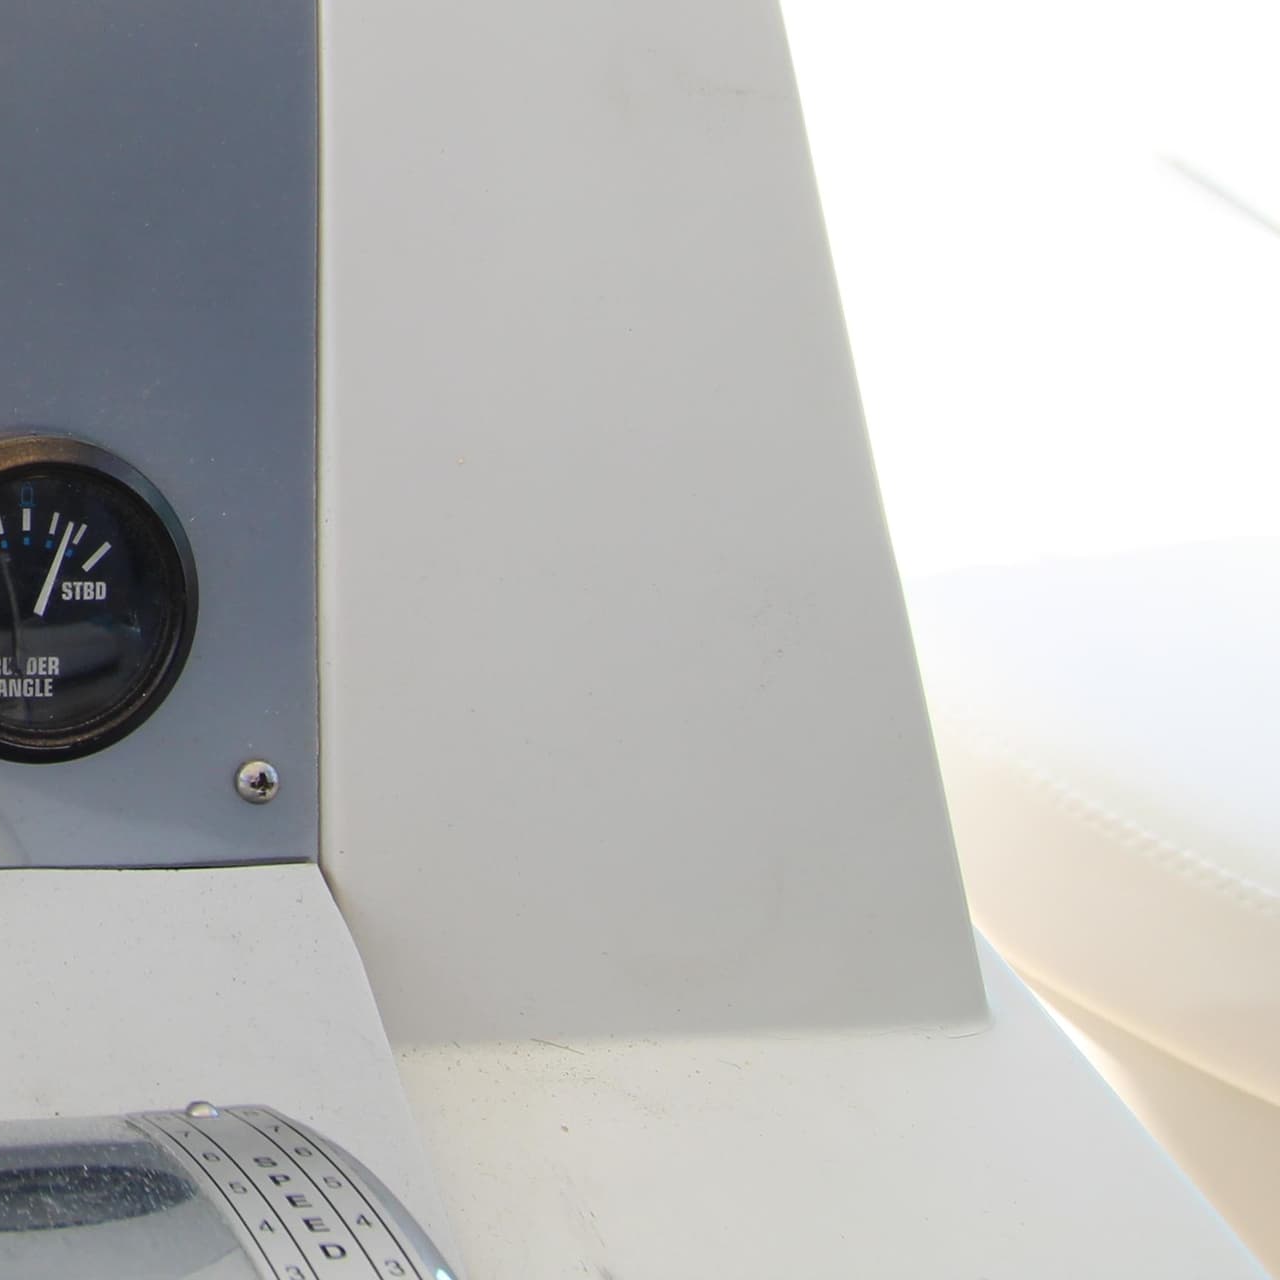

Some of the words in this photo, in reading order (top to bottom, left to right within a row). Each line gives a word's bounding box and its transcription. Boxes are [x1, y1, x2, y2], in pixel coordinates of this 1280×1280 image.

[61, 581, 107, 601] STBD
[355, 1214, 373, 1228] 4
[385, 1259, 406, 1277] 3
